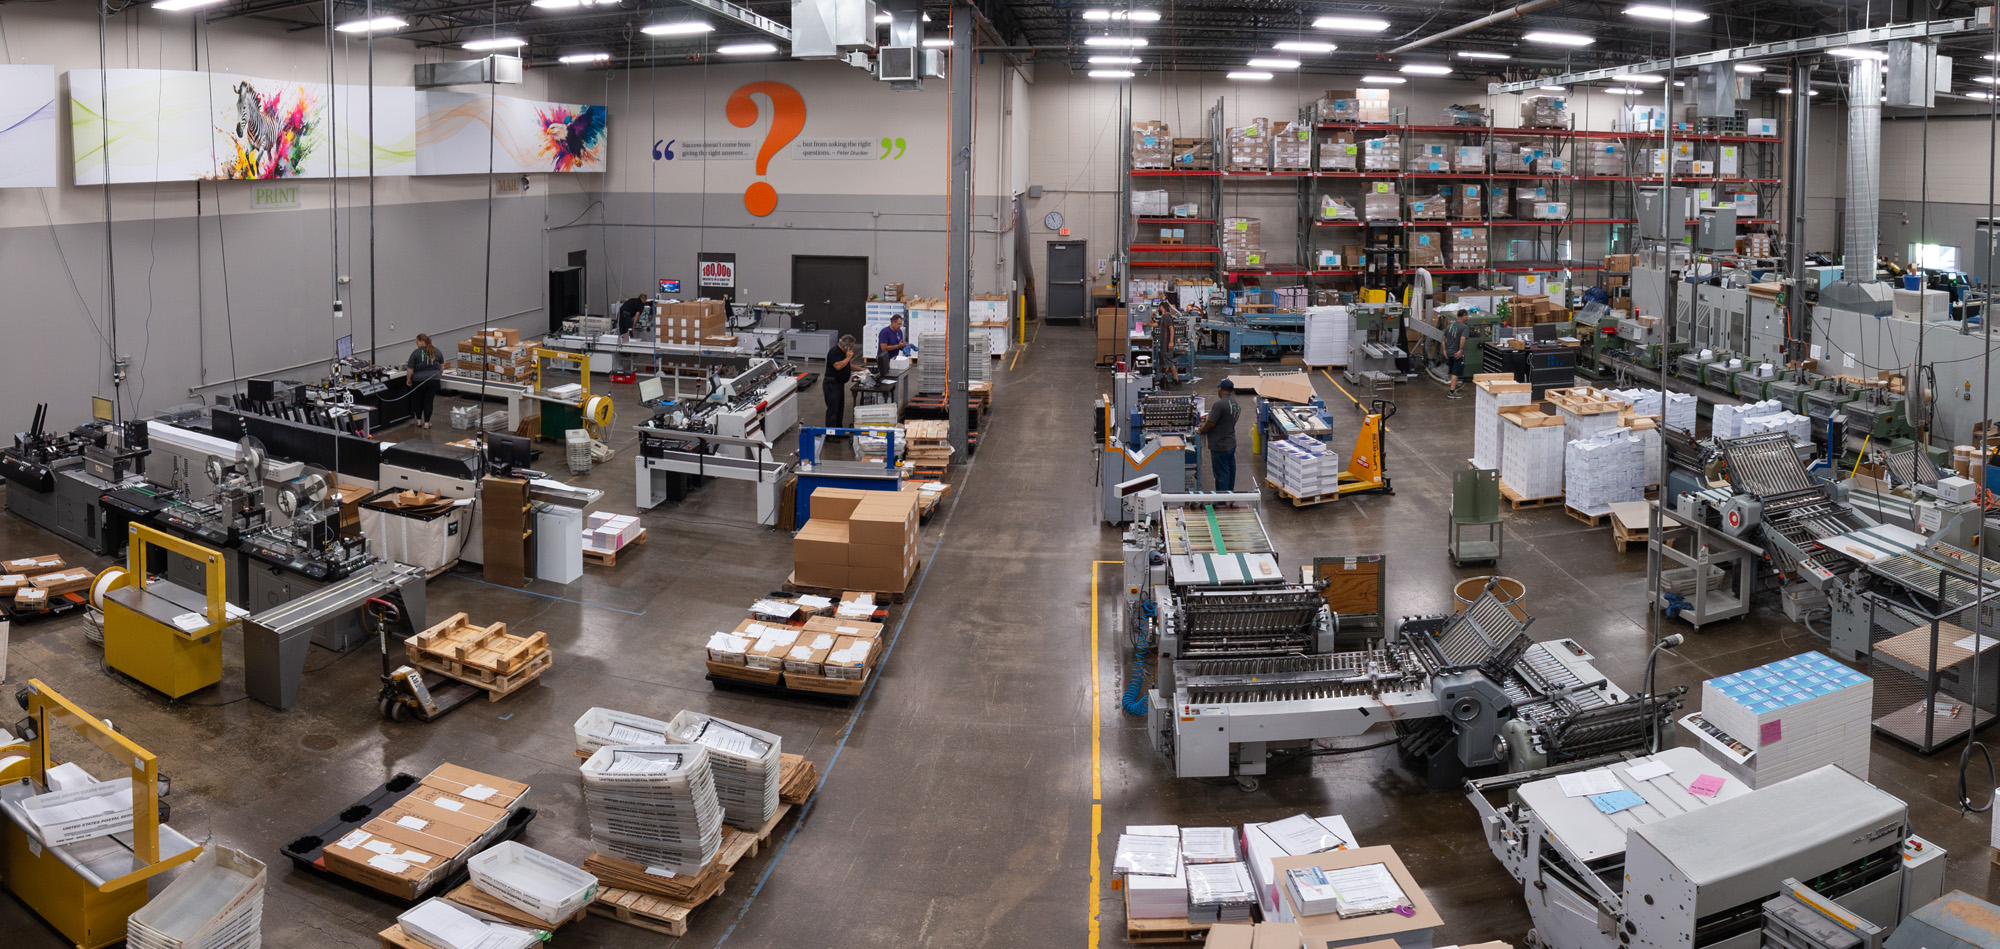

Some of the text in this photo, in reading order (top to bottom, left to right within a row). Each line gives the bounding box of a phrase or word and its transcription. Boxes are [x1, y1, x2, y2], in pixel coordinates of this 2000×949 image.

[498, 178, 518, 191] MAIL
[256, 188, 298, 204] PRINT
[702, 263, 731, 278] 180,000
[494, 879, 507, 888] STATES
[508, 885, 522, 896] POSTAL
[524, 893, 540, 902] SERVICE
[507, 892, 521, 901] POSTAL
[523, 900, 540, 909] SERVICE
